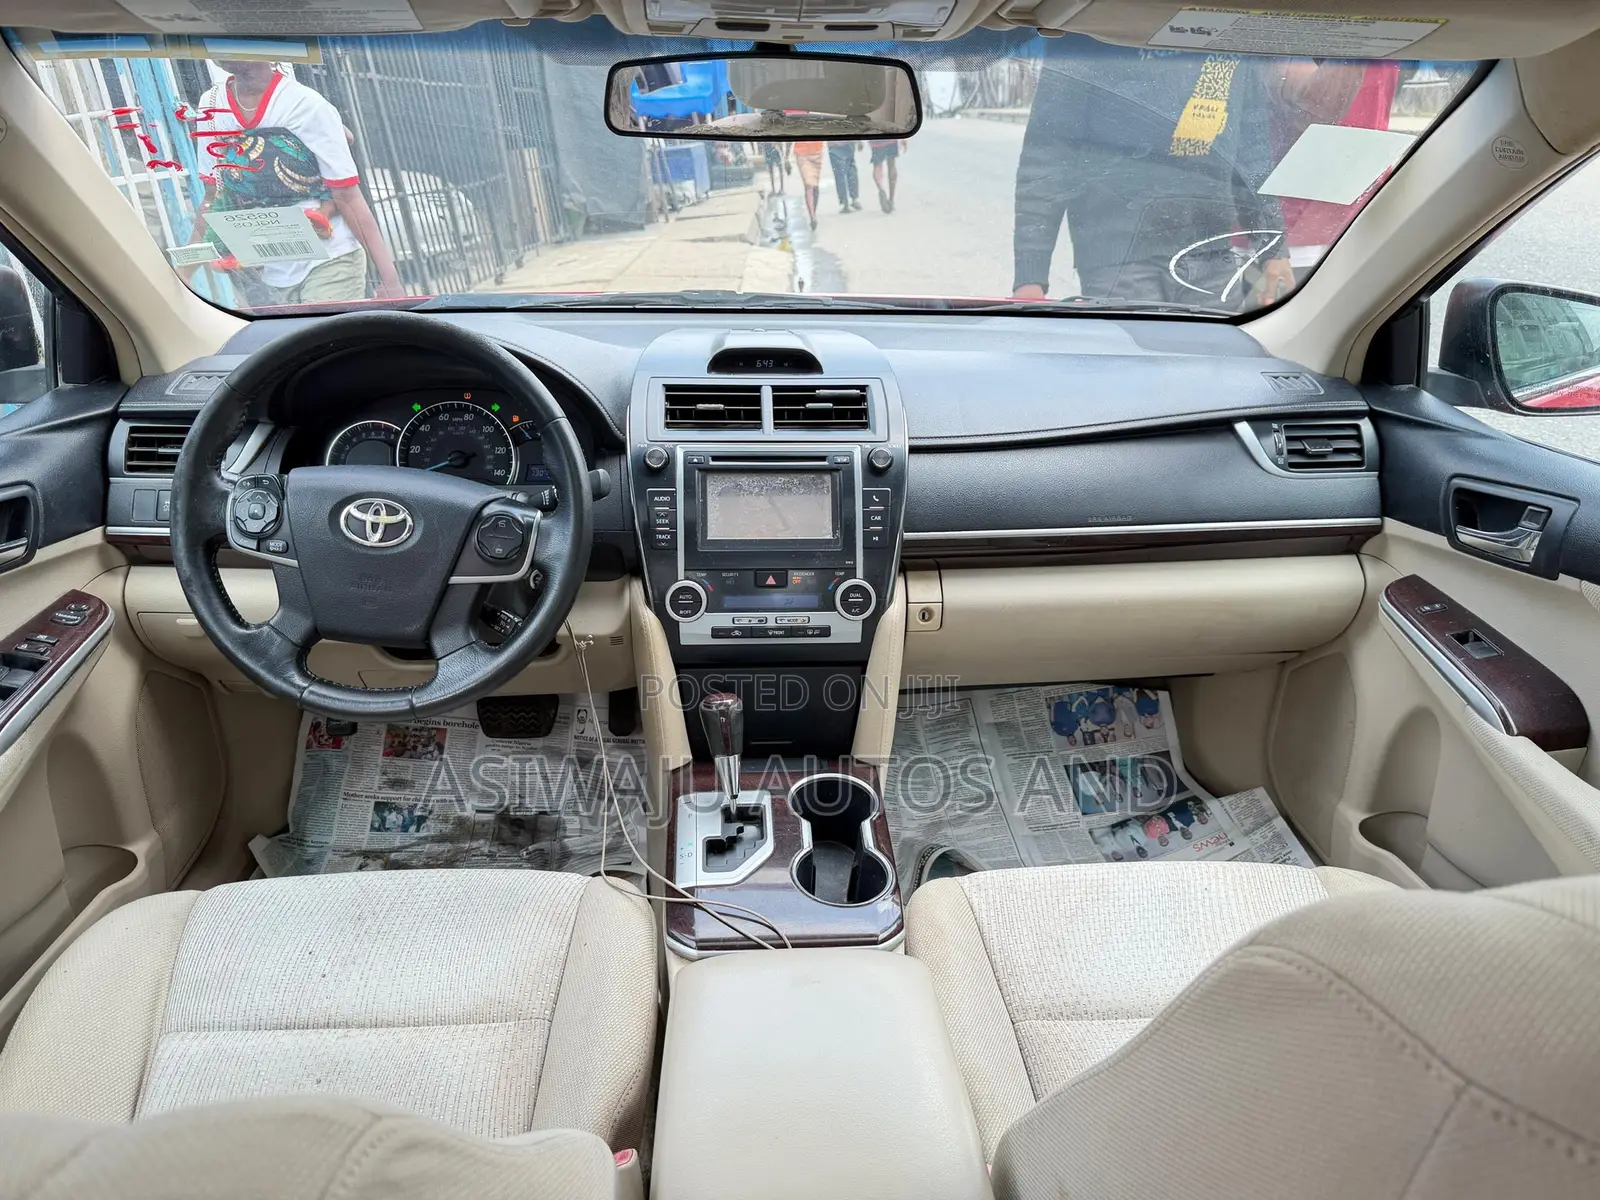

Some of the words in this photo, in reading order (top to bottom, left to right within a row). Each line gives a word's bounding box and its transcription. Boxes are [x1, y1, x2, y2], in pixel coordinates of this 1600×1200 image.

[419, 424, 430, 432] 40
[482, 425, 494, 433] 100
[409, 445, 421, 453] 20
[494, 446, 506, 454] 120
[414, 717, 441, 726] begins
[442, 718, 480, 730] borehole
[380, 795, 402, 803] support
[1192, 831, 1229, 853] news
